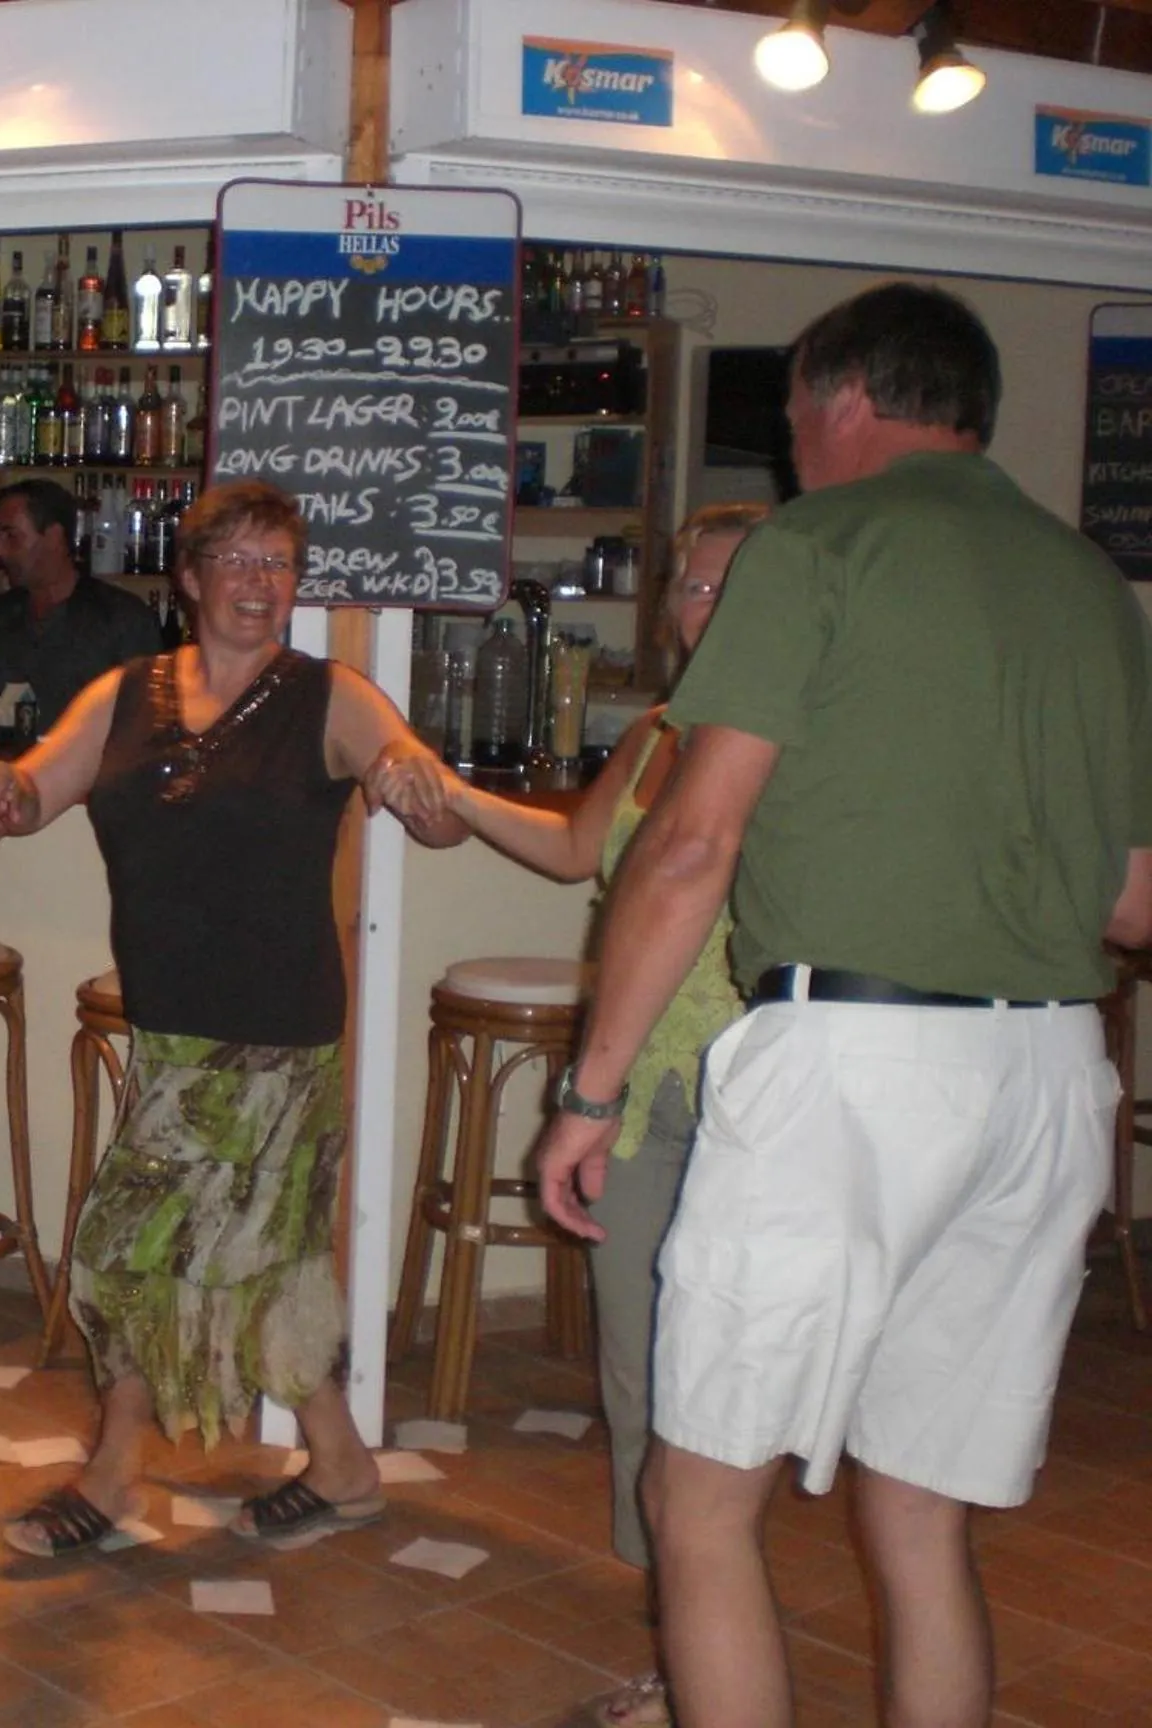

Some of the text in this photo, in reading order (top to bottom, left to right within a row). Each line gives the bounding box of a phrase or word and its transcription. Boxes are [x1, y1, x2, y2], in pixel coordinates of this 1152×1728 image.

[344, 199, 400, 230] Pils
[339, 234, 400, 254] HELLAS
[231, 277, 350, 323] HAPPY
[219, 395, 305, 433] PINT
[214, 444, 299, 475] LONG
